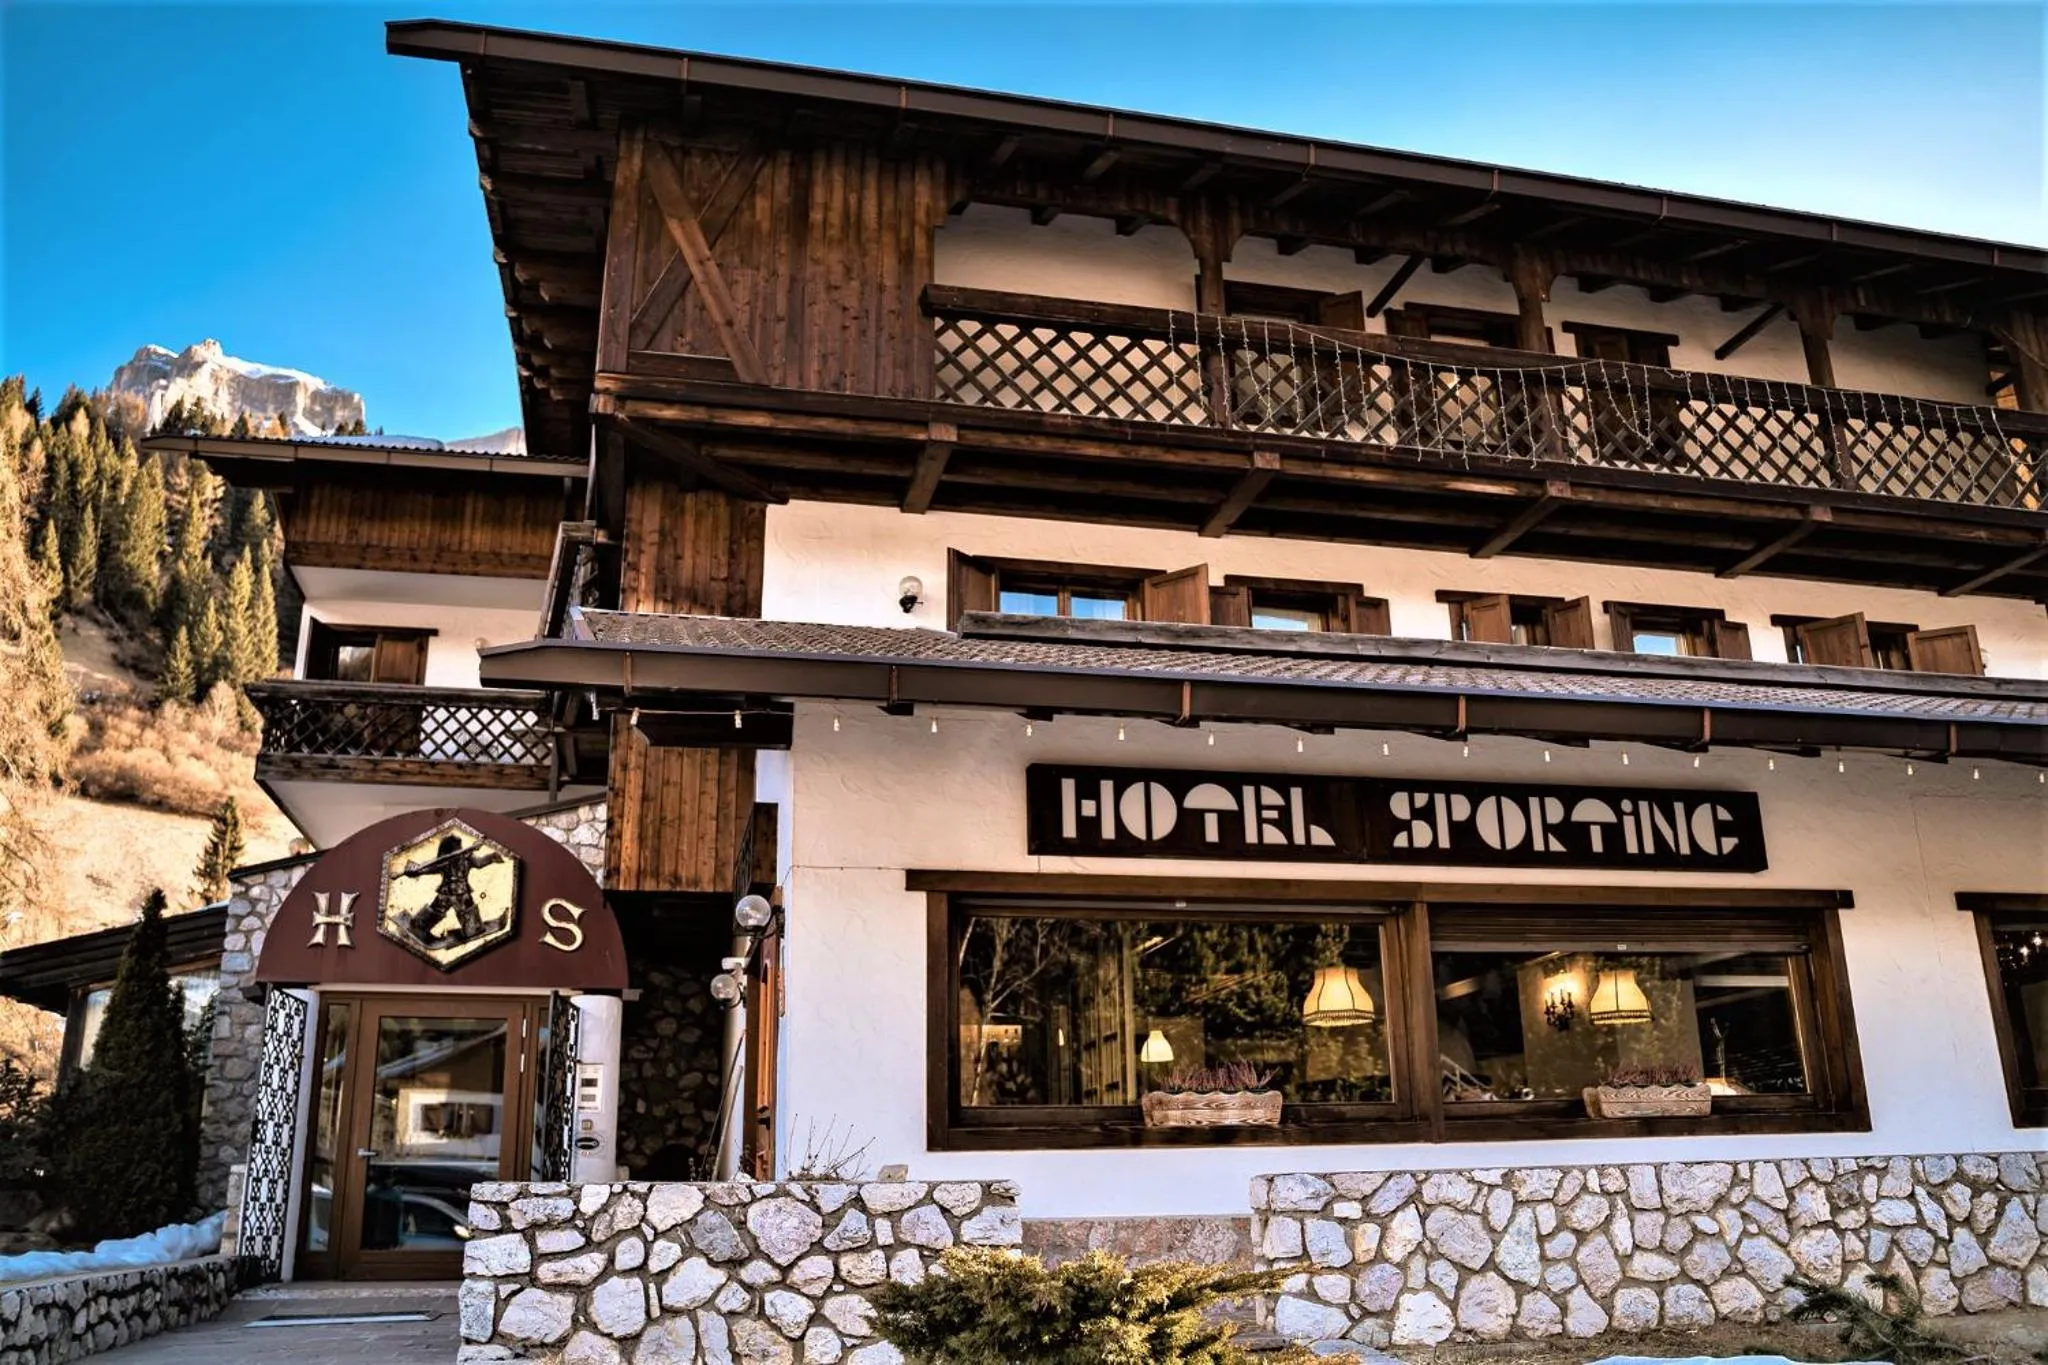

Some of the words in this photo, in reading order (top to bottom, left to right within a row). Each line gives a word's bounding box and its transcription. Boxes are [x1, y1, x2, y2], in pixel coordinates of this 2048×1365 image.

[1061, 778, 1336, 846] HOTEL
[307, 891, 361, 948] H
[539, 897, 588, 952] S
